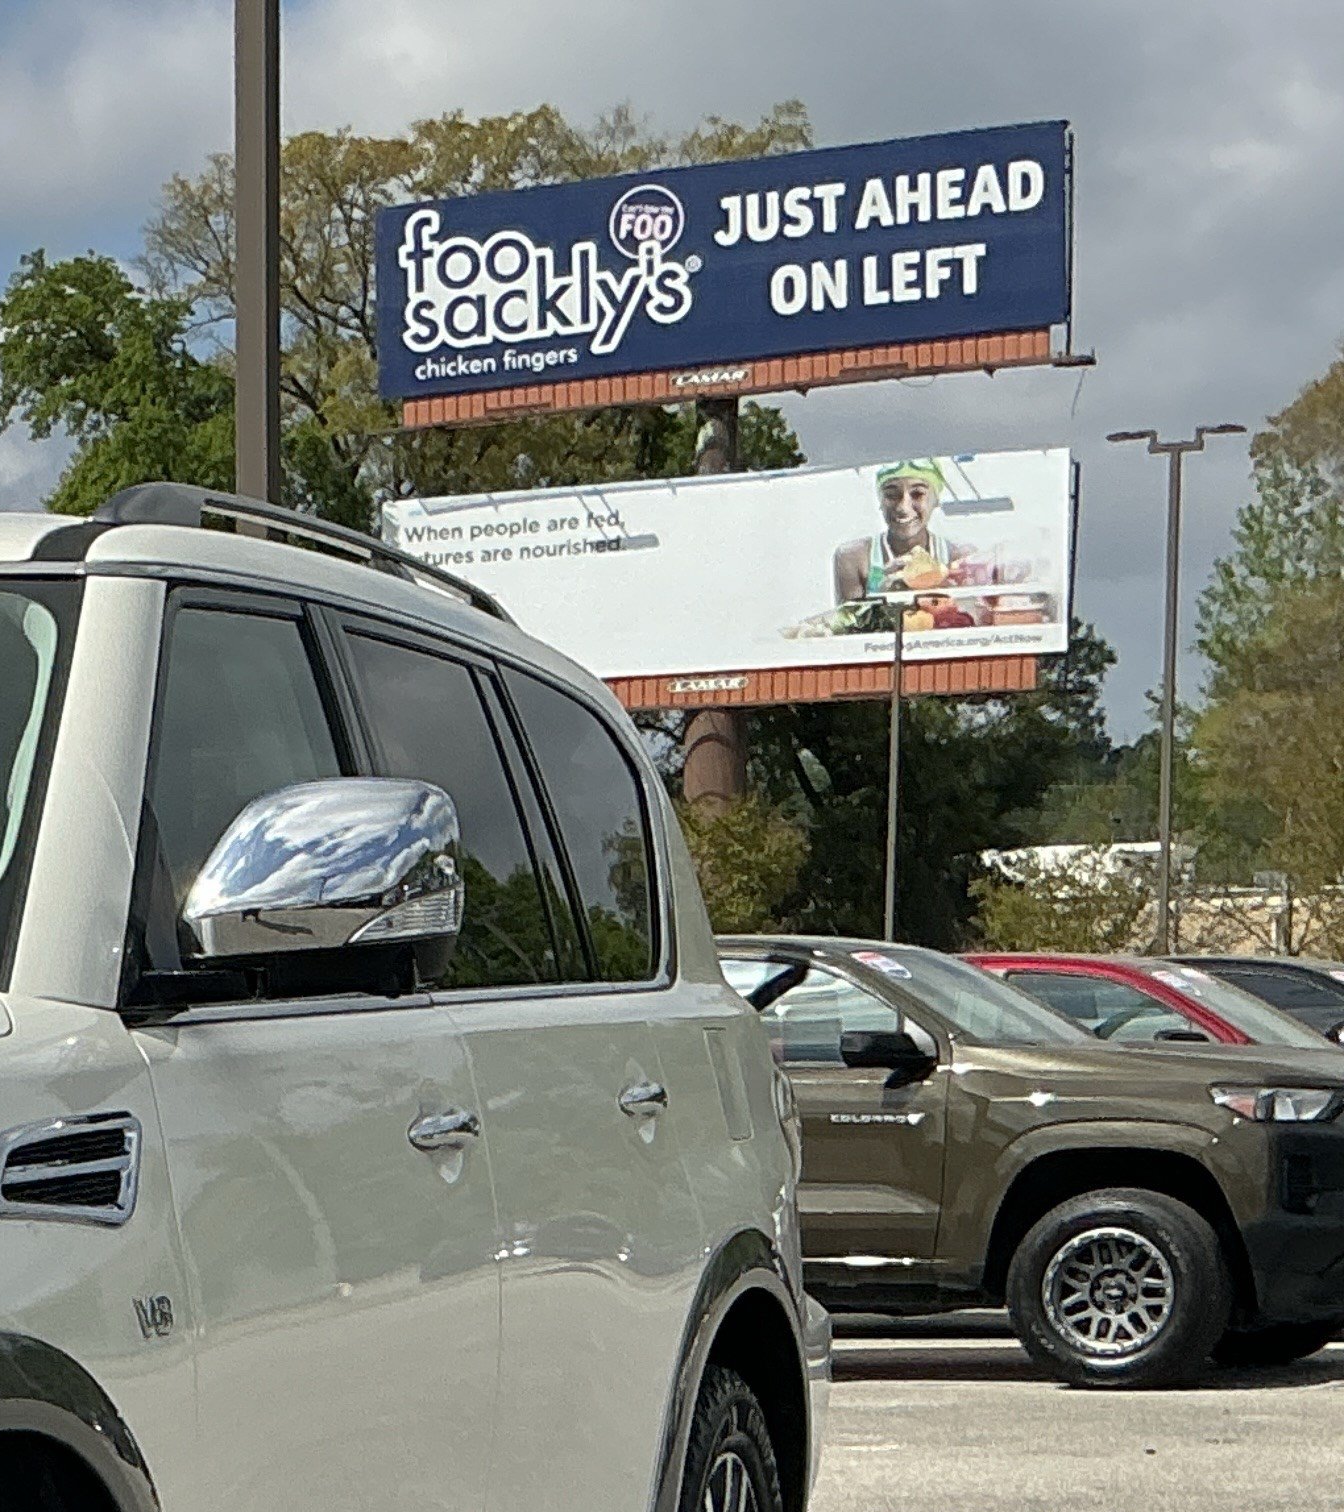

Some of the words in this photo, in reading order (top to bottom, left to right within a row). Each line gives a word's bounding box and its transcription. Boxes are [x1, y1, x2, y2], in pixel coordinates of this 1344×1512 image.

[713, 182, 846, 246] JUST
[855, 159, 1046, 229] AHEAD
[619, 213, 673, 241] FOO
[399, 209, 534, 294] foo
[771, 258, 847, 316] ON
[863, 244, 988, 304] LEFT
[415, 353, 496, 380] chicken
[503, 347, 578, 373] fingers
[404, 525, 463, 543] When
[470, 517, 541, 541] people
[547, 516, 580, 532] are
[416, 550, 475, 566] tures
[481, 547, 513, 563] are
[519, 537, 626, 561] nourished.
[132, 1295, 173, 1340] V8
